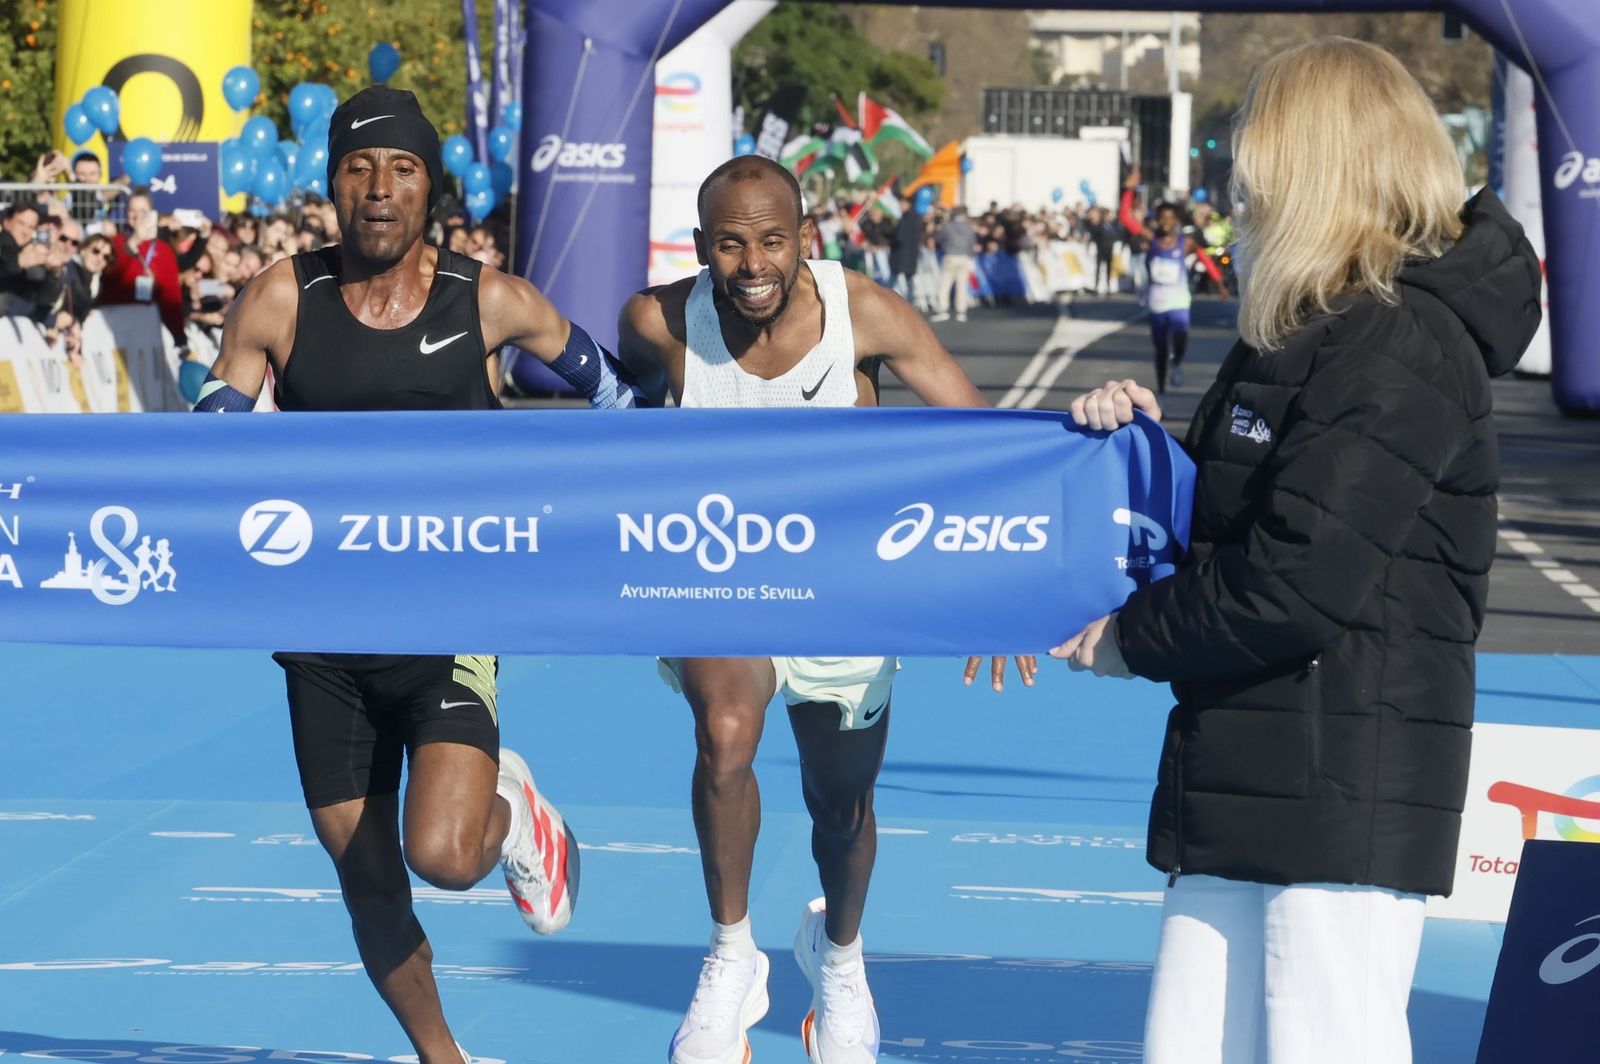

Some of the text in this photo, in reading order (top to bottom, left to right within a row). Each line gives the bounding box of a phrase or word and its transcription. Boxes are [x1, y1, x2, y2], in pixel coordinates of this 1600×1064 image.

[558, 143, 627, 168] asics
[338, 514, 538, 553] ZURICH
[933, 515, 1050, 552] asics
[620, 583, 815, 600] AYUNTAMIENTO DE SEVILLA
